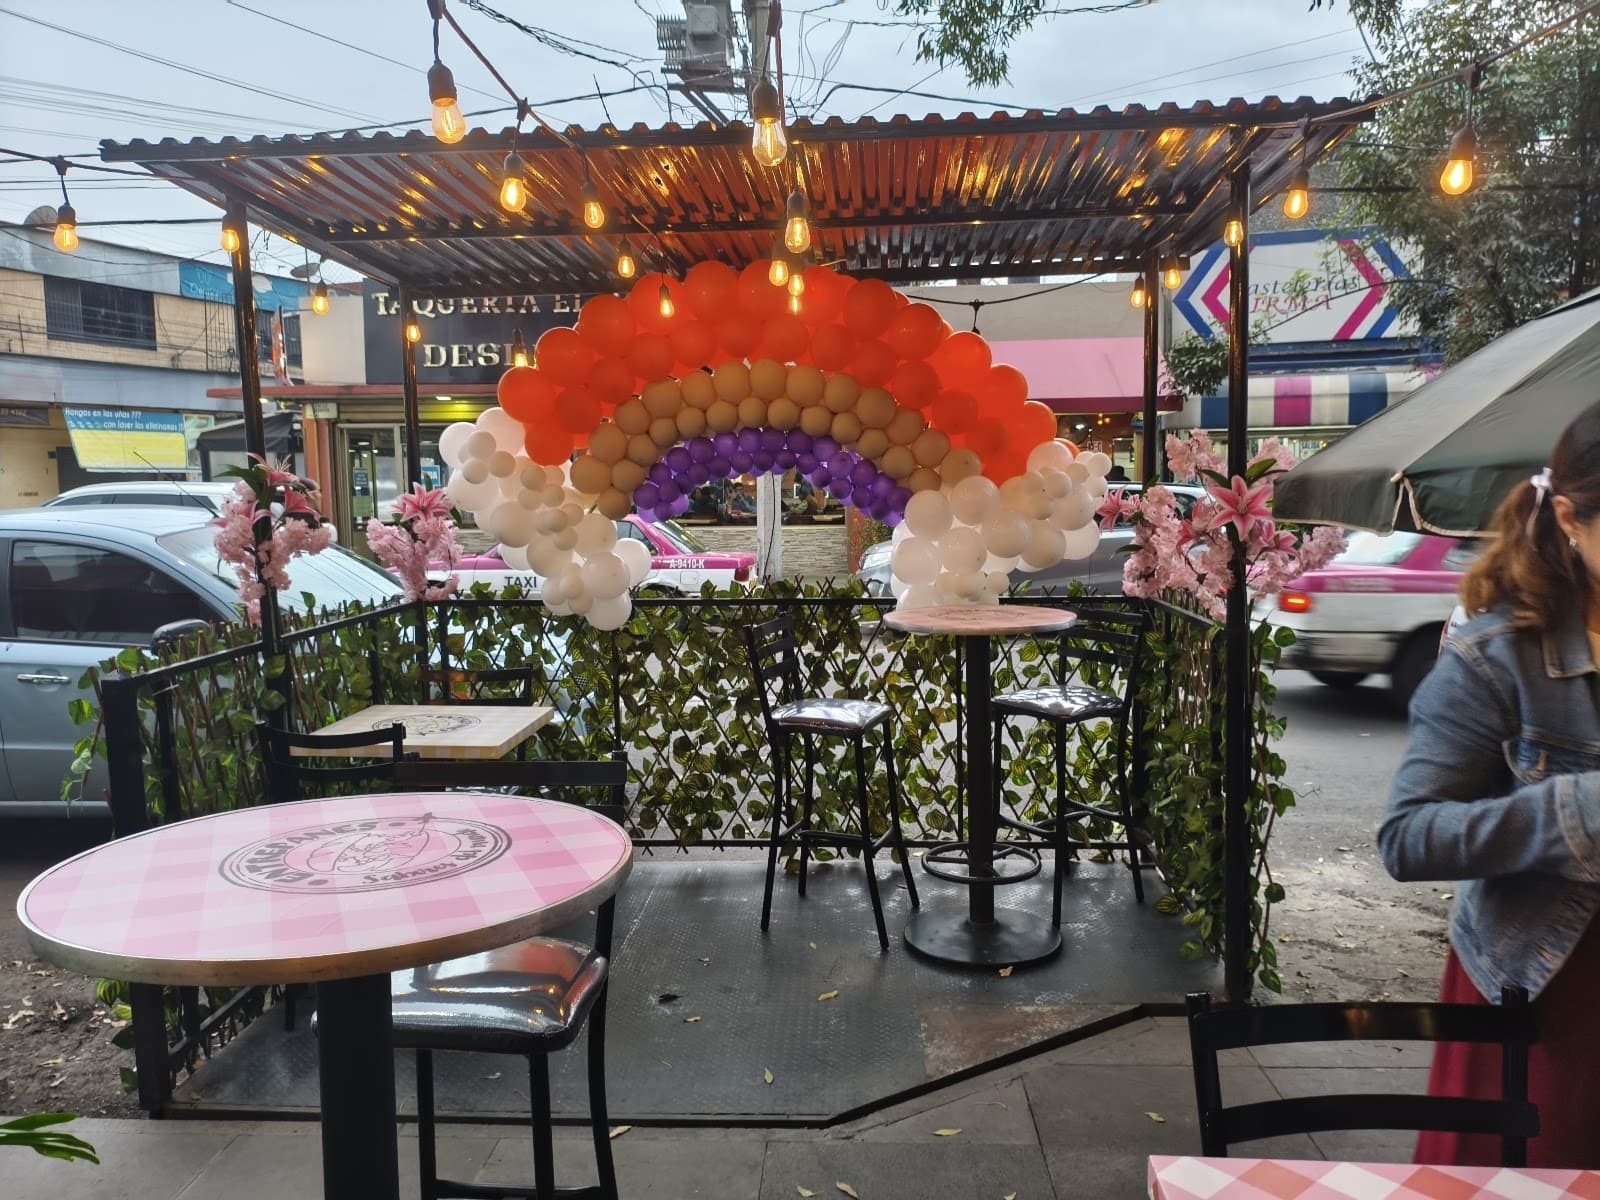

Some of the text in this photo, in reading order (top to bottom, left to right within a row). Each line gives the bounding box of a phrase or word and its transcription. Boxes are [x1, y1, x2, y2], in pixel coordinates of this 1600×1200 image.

[1249, 294, 1333, 315] IRMA
[65, 407, 91, 418] Hongos
[92, 410, 102, 418] en
[103, 409, 113, 418] las
[114, 409, 130, 419] uñas
[103, 421, 116, 429] con
[669, 558, 705, 569] A-9410-K
[504, 576, 537, 588] TAXI
[244, 820, 380, 884] ENTREPANES
